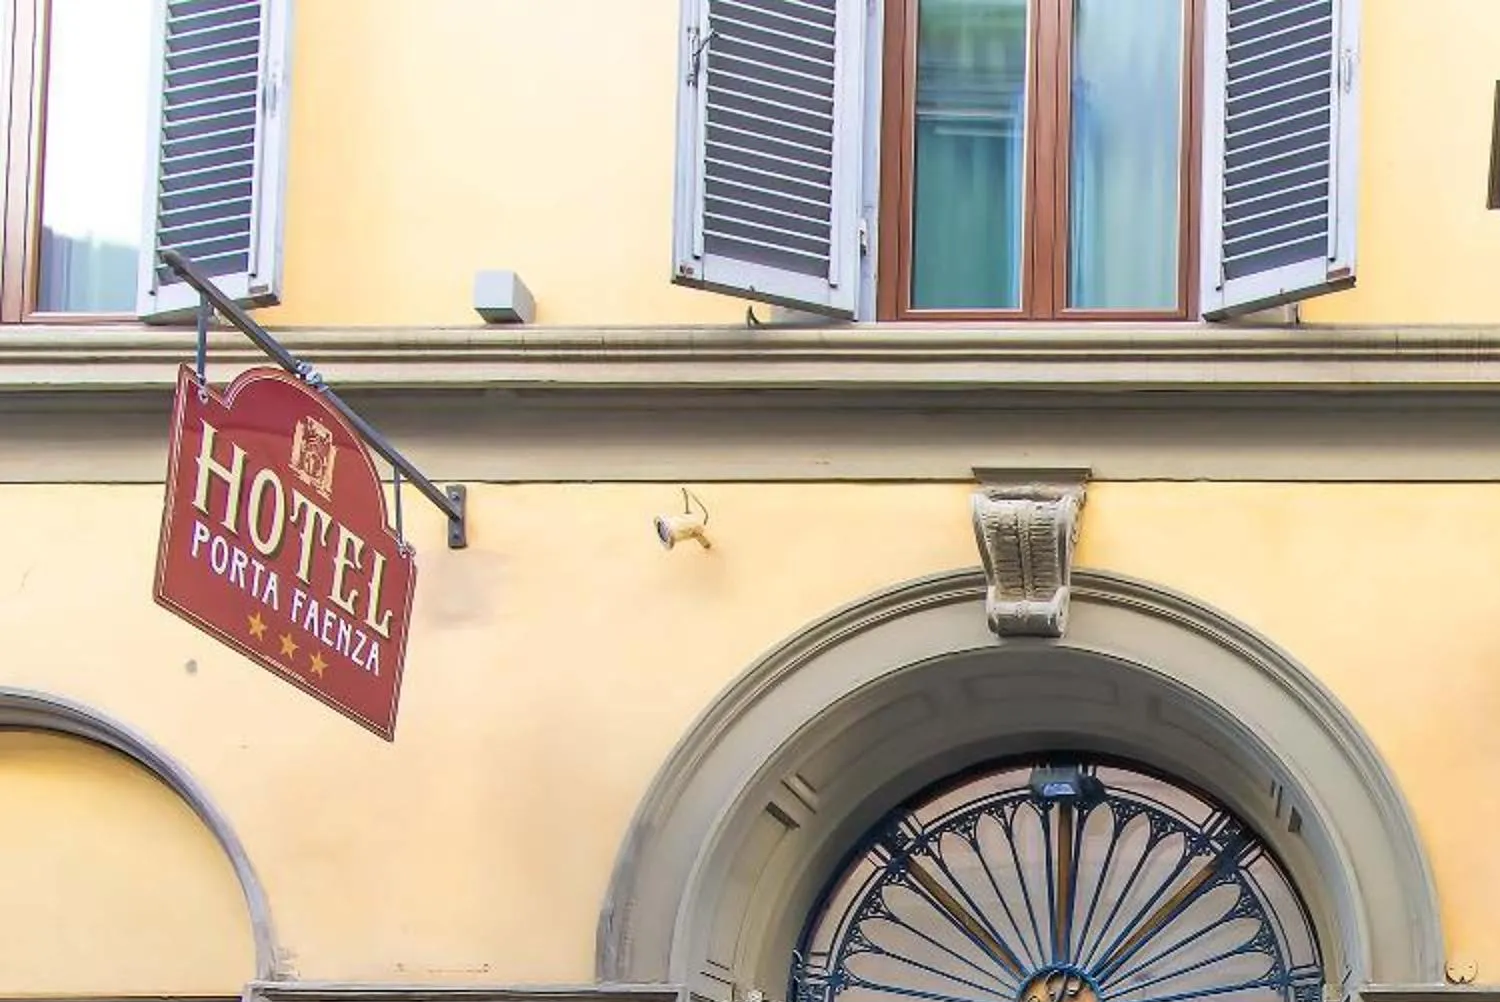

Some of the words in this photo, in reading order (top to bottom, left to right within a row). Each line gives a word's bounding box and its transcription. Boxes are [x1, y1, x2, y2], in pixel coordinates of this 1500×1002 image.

[191, 418, 393, 639] HOTEL
[191, 520, 279, 611] PORTA
[290, 588, 381, 677] FAENZA
